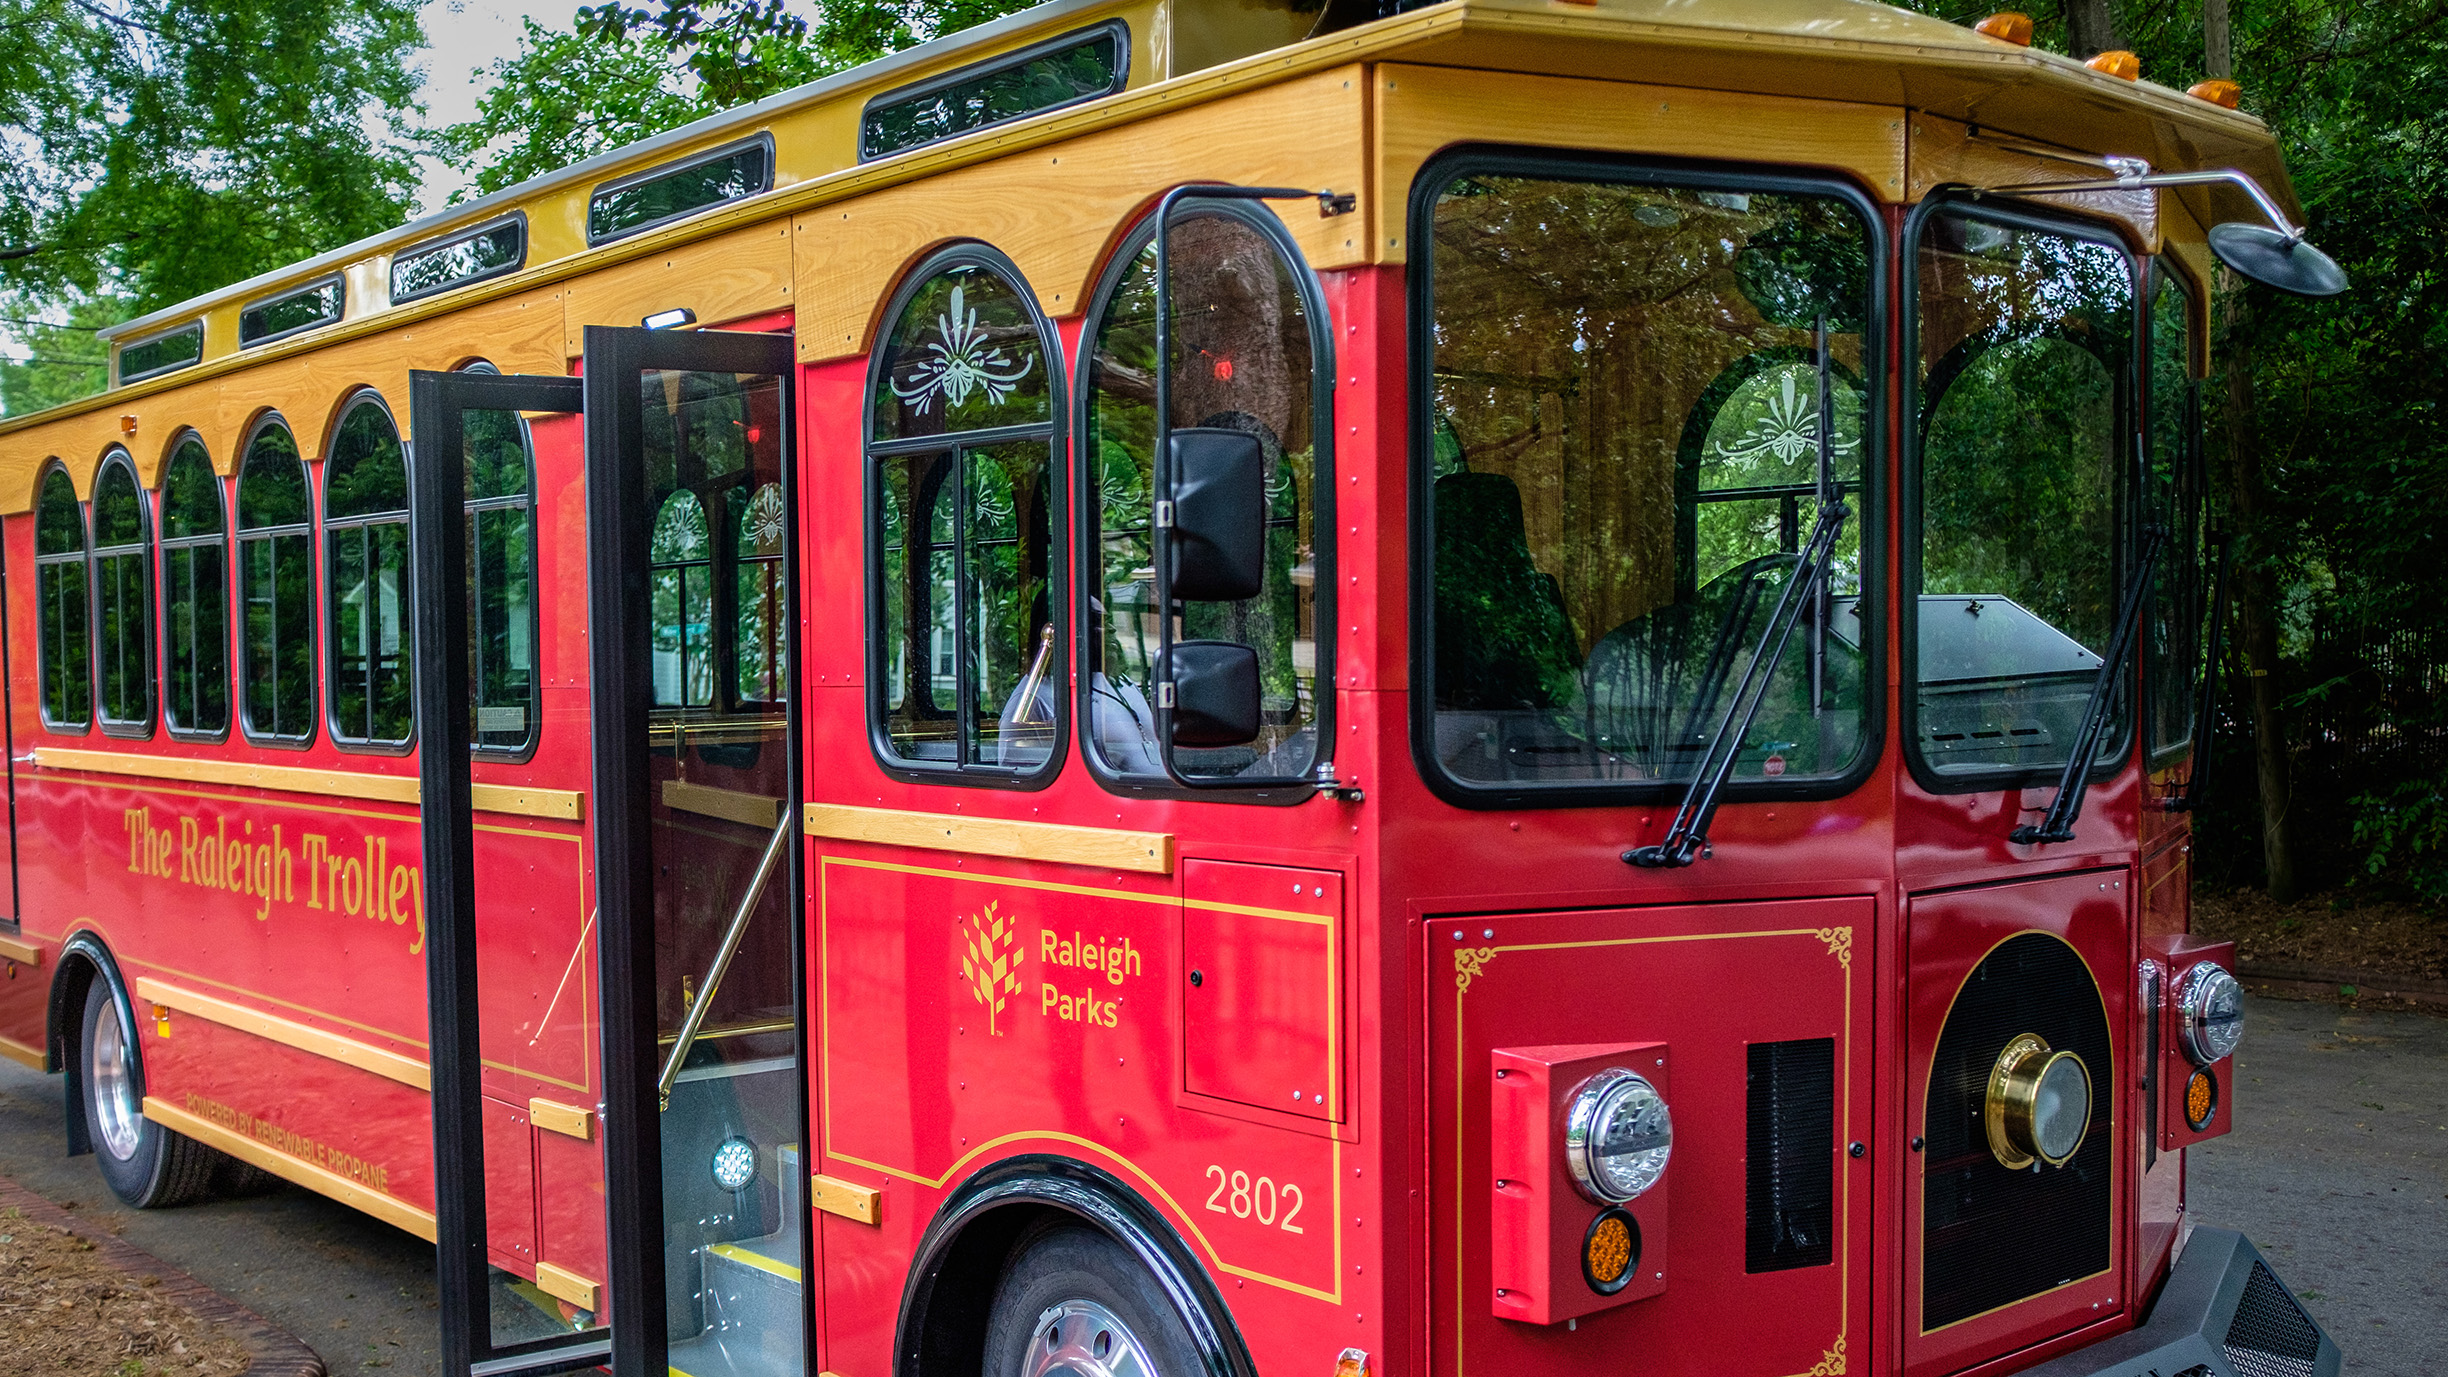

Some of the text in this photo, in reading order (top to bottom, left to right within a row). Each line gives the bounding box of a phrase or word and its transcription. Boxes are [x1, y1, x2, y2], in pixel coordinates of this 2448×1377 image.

[124, 806, 425, 955] The Raleigh Trolley
[1041, 929, 1141, 985] Raleigh
[1042, 983, 1118, 1028] Parks
[186, 1092, 389, 1193] POWERED BY RENEWABLE PROPANE
[1205, 1164, 1303, 1235] 2802
